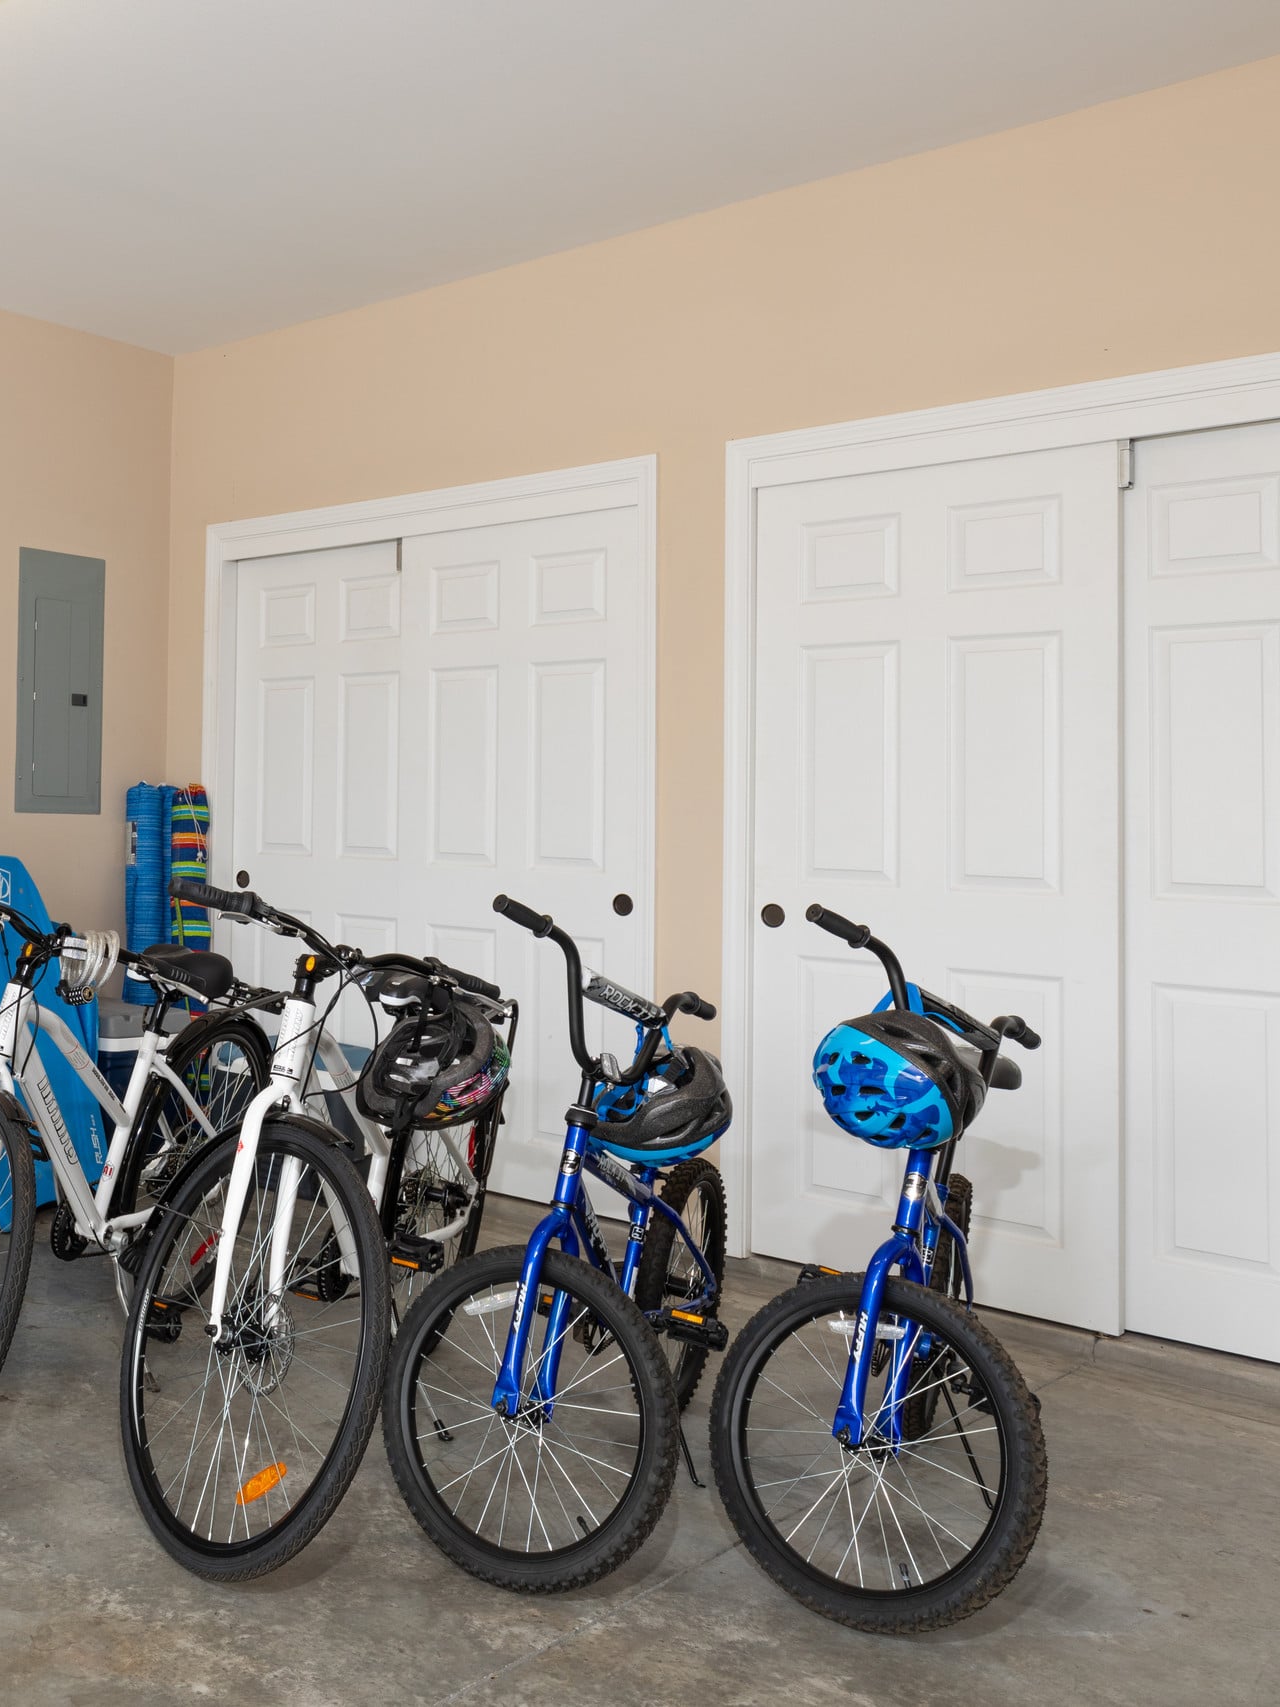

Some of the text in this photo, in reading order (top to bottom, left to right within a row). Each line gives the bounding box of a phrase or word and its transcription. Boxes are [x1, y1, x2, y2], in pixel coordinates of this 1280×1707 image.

[90, 1127, 103, 1164] RUSH
[513, 1283, 528, 1333] HUFFY
[854, 1311, 869, 1362] HUFFY
